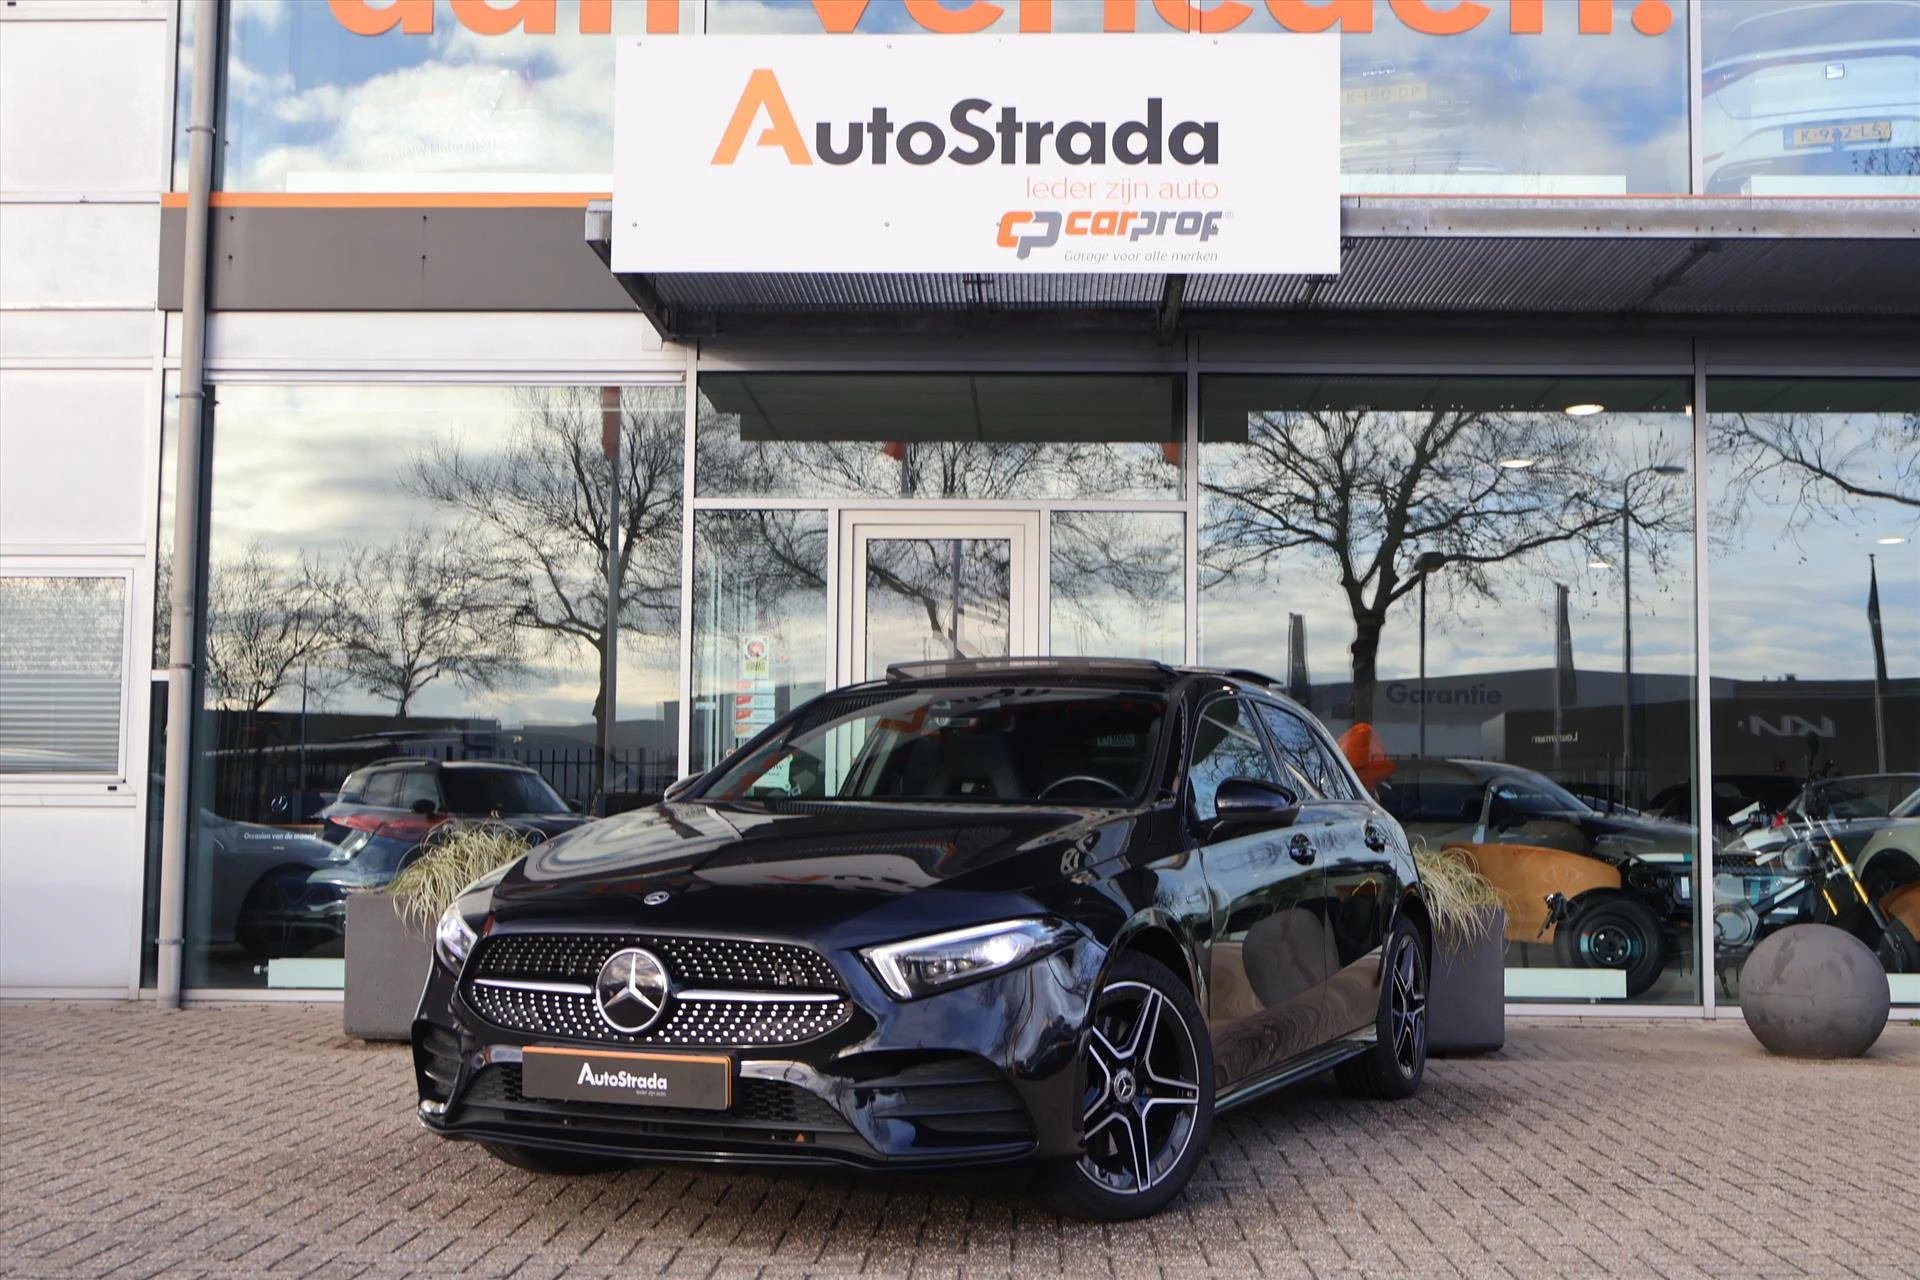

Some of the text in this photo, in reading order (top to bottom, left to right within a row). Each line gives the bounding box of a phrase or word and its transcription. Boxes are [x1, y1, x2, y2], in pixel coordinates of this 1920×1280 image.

[710, 68, 1219, 165] AutoStrada
[1800, 124, 1882, 143] K-92-LS
[1026, 176, 1220, 206] Ieder zijn auto
[1064, 250, 1219, 263] Garage voor alle merken
[1386, 682, 1502, 705] Garantie
[577, 1062, 668, 1090] AutoStrada
